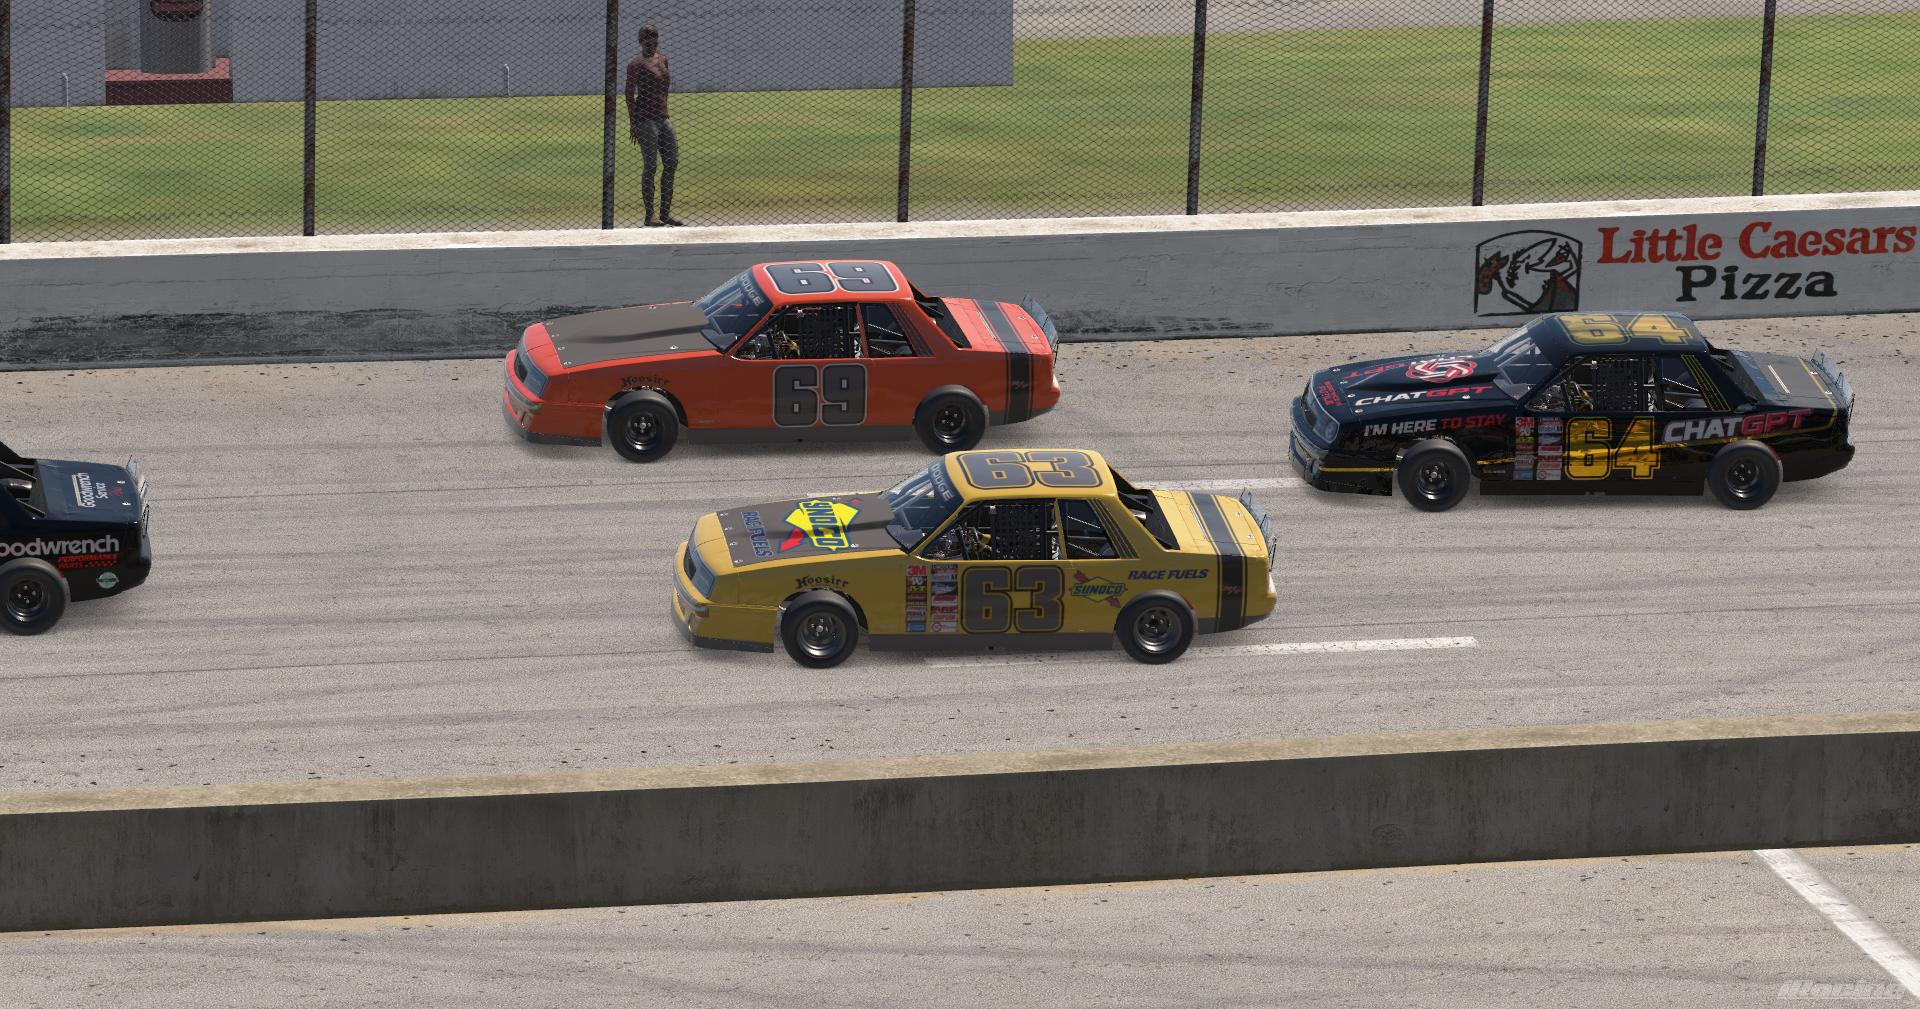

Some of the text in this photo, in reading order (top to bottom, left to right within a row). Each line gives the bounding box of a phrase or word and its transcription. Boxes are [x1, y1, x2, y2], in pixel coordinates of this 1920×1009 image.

[1597, 221, 1917, 263] Little Caesars
[762, 261, 899, 295] 69
[1675, 265, 1838, 302] Pizza
[1555, 313, 1693, 346] 64
[772, 363, 868, 428] 69
[1354, 385, 1495, 407] CHATGPT
[1363, 413, 1507, 437] I'M HERE TO STAY
[1664, 408, 1813, 443] CHATGPT
[1565, 416, 1661, 480] 64
[931, 463, 955, 501] DODGE
[956, 450, 1103, 490] 63
[0, 534, 119, 557] oodwrench
[795, 575, 849, 589] Hoosier
[906, 564, 928, 576] 3M
[1128, 568, 1209, 580] RACE FUELS
[961, 565, 1065, 634] 63
[1073, 583, 1123, 596] SUNOCO
